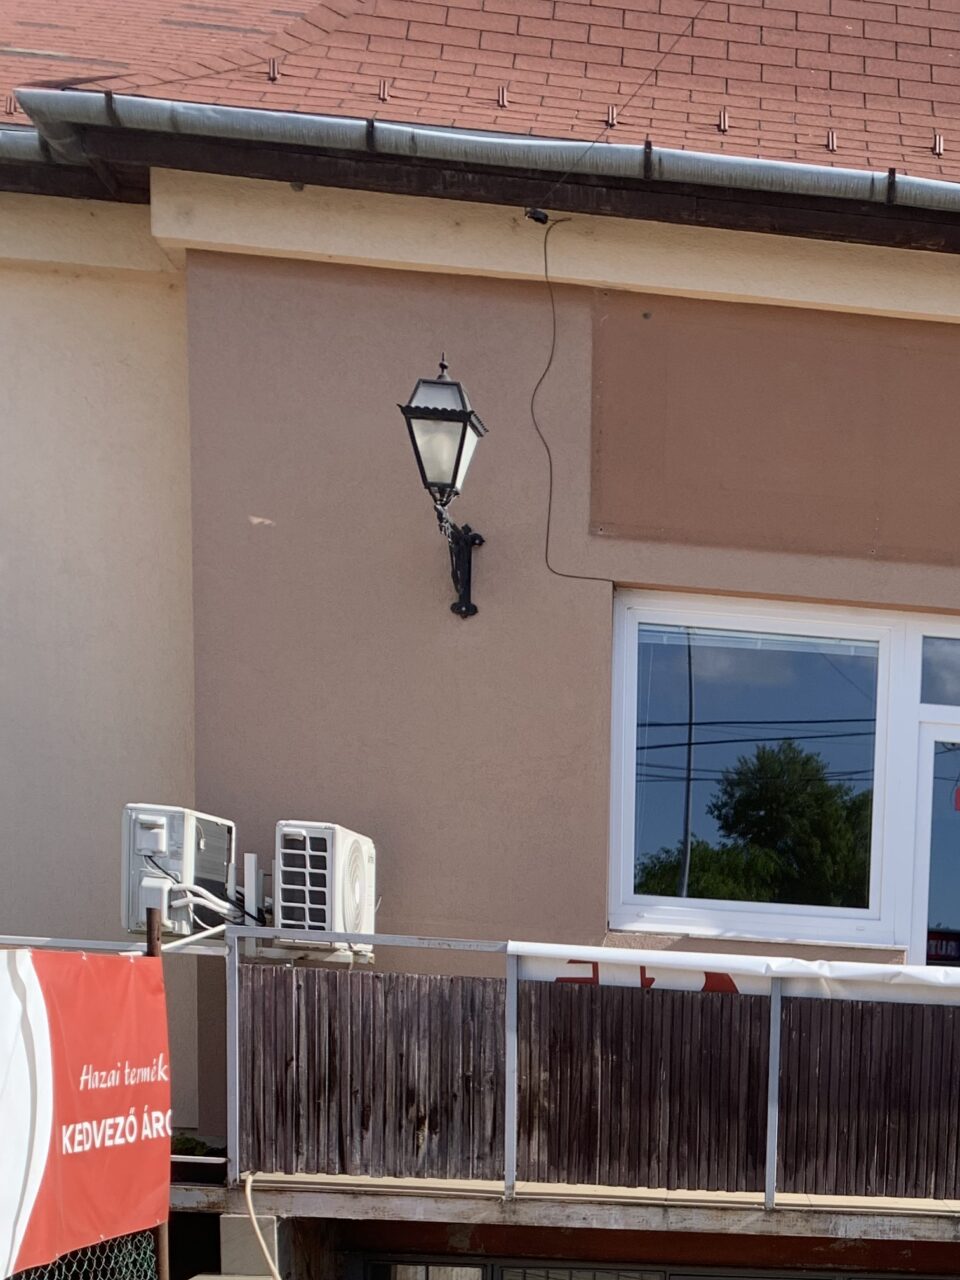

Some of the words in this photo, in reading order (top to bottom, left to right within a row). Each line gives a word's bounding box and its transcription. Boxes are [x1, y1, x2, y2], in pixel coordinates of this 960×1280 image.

[79, 1061, 121, 1091] Hazai
[124, 1052, 169, 1086] termék
[61, 1106, 138, 1155] KEDVEZŐ
